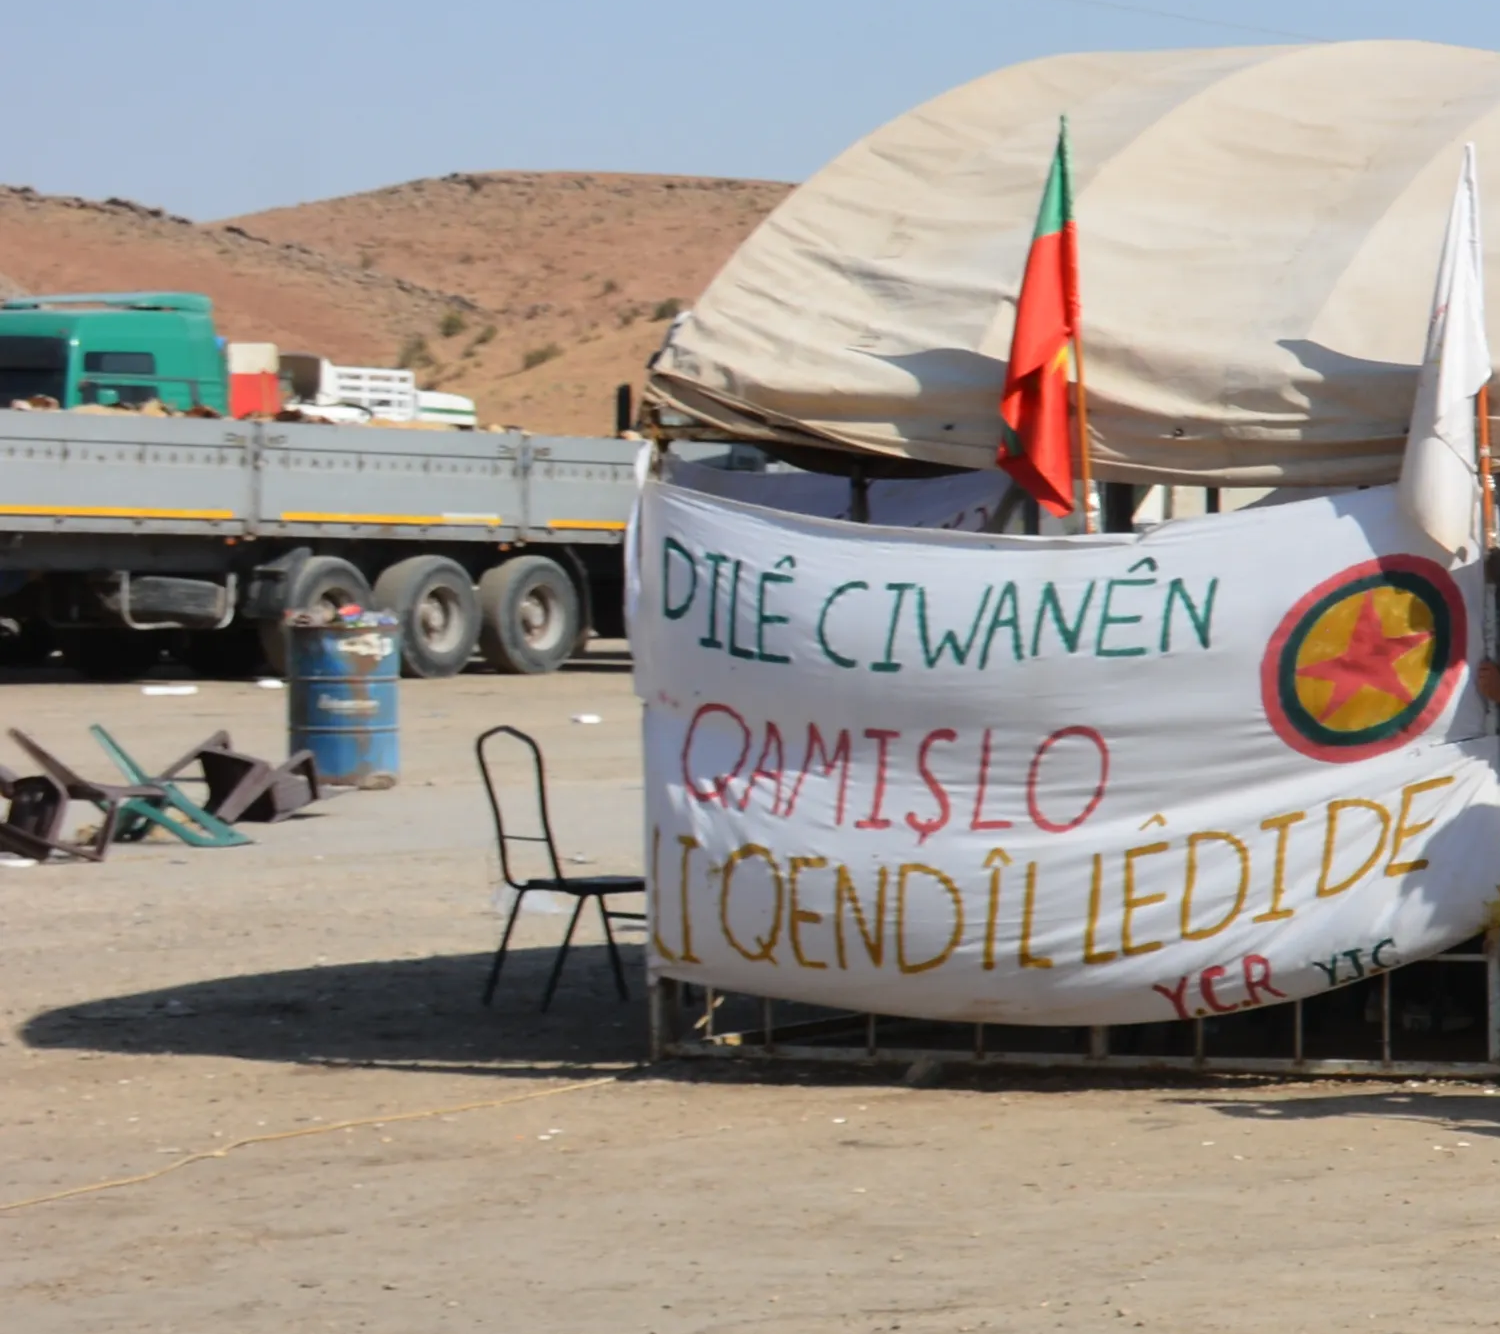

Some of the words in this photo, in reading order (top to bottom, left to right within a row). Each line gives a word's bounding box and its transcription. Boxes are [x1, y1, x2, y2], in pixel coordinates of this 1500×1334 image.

[664, 535, 796, 663] DILÊ
[817, 556, 1218, 673] CIWANÊN
[681, 702, 1110, 844] QAMIŞLO
